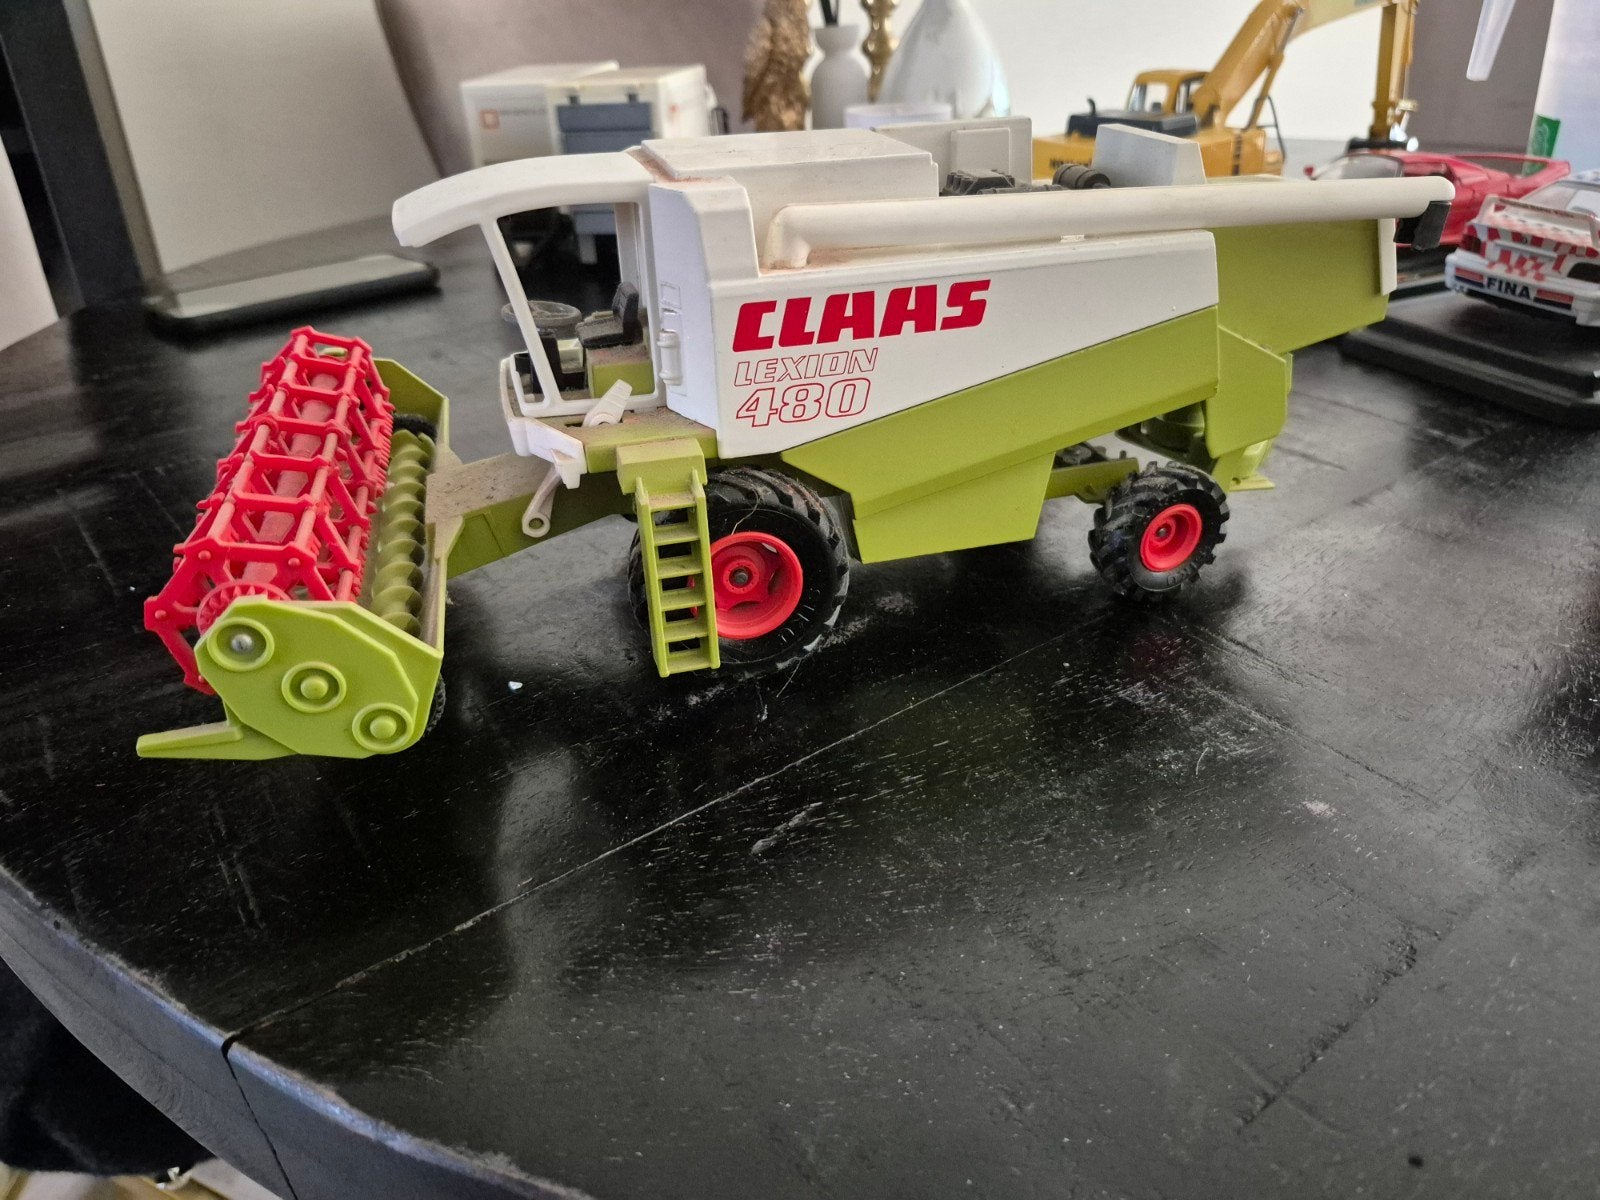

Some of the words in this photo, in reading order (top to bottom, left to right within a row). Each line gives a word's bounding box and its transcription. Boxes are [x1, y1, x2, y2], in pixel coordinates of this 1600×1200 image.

[1487, 277, 1531, 300] FINA
[732, 279, 991, 353] CLAAS
[734, 347, 879, 387] LEXION
[736, 377, 871, 428] 480
